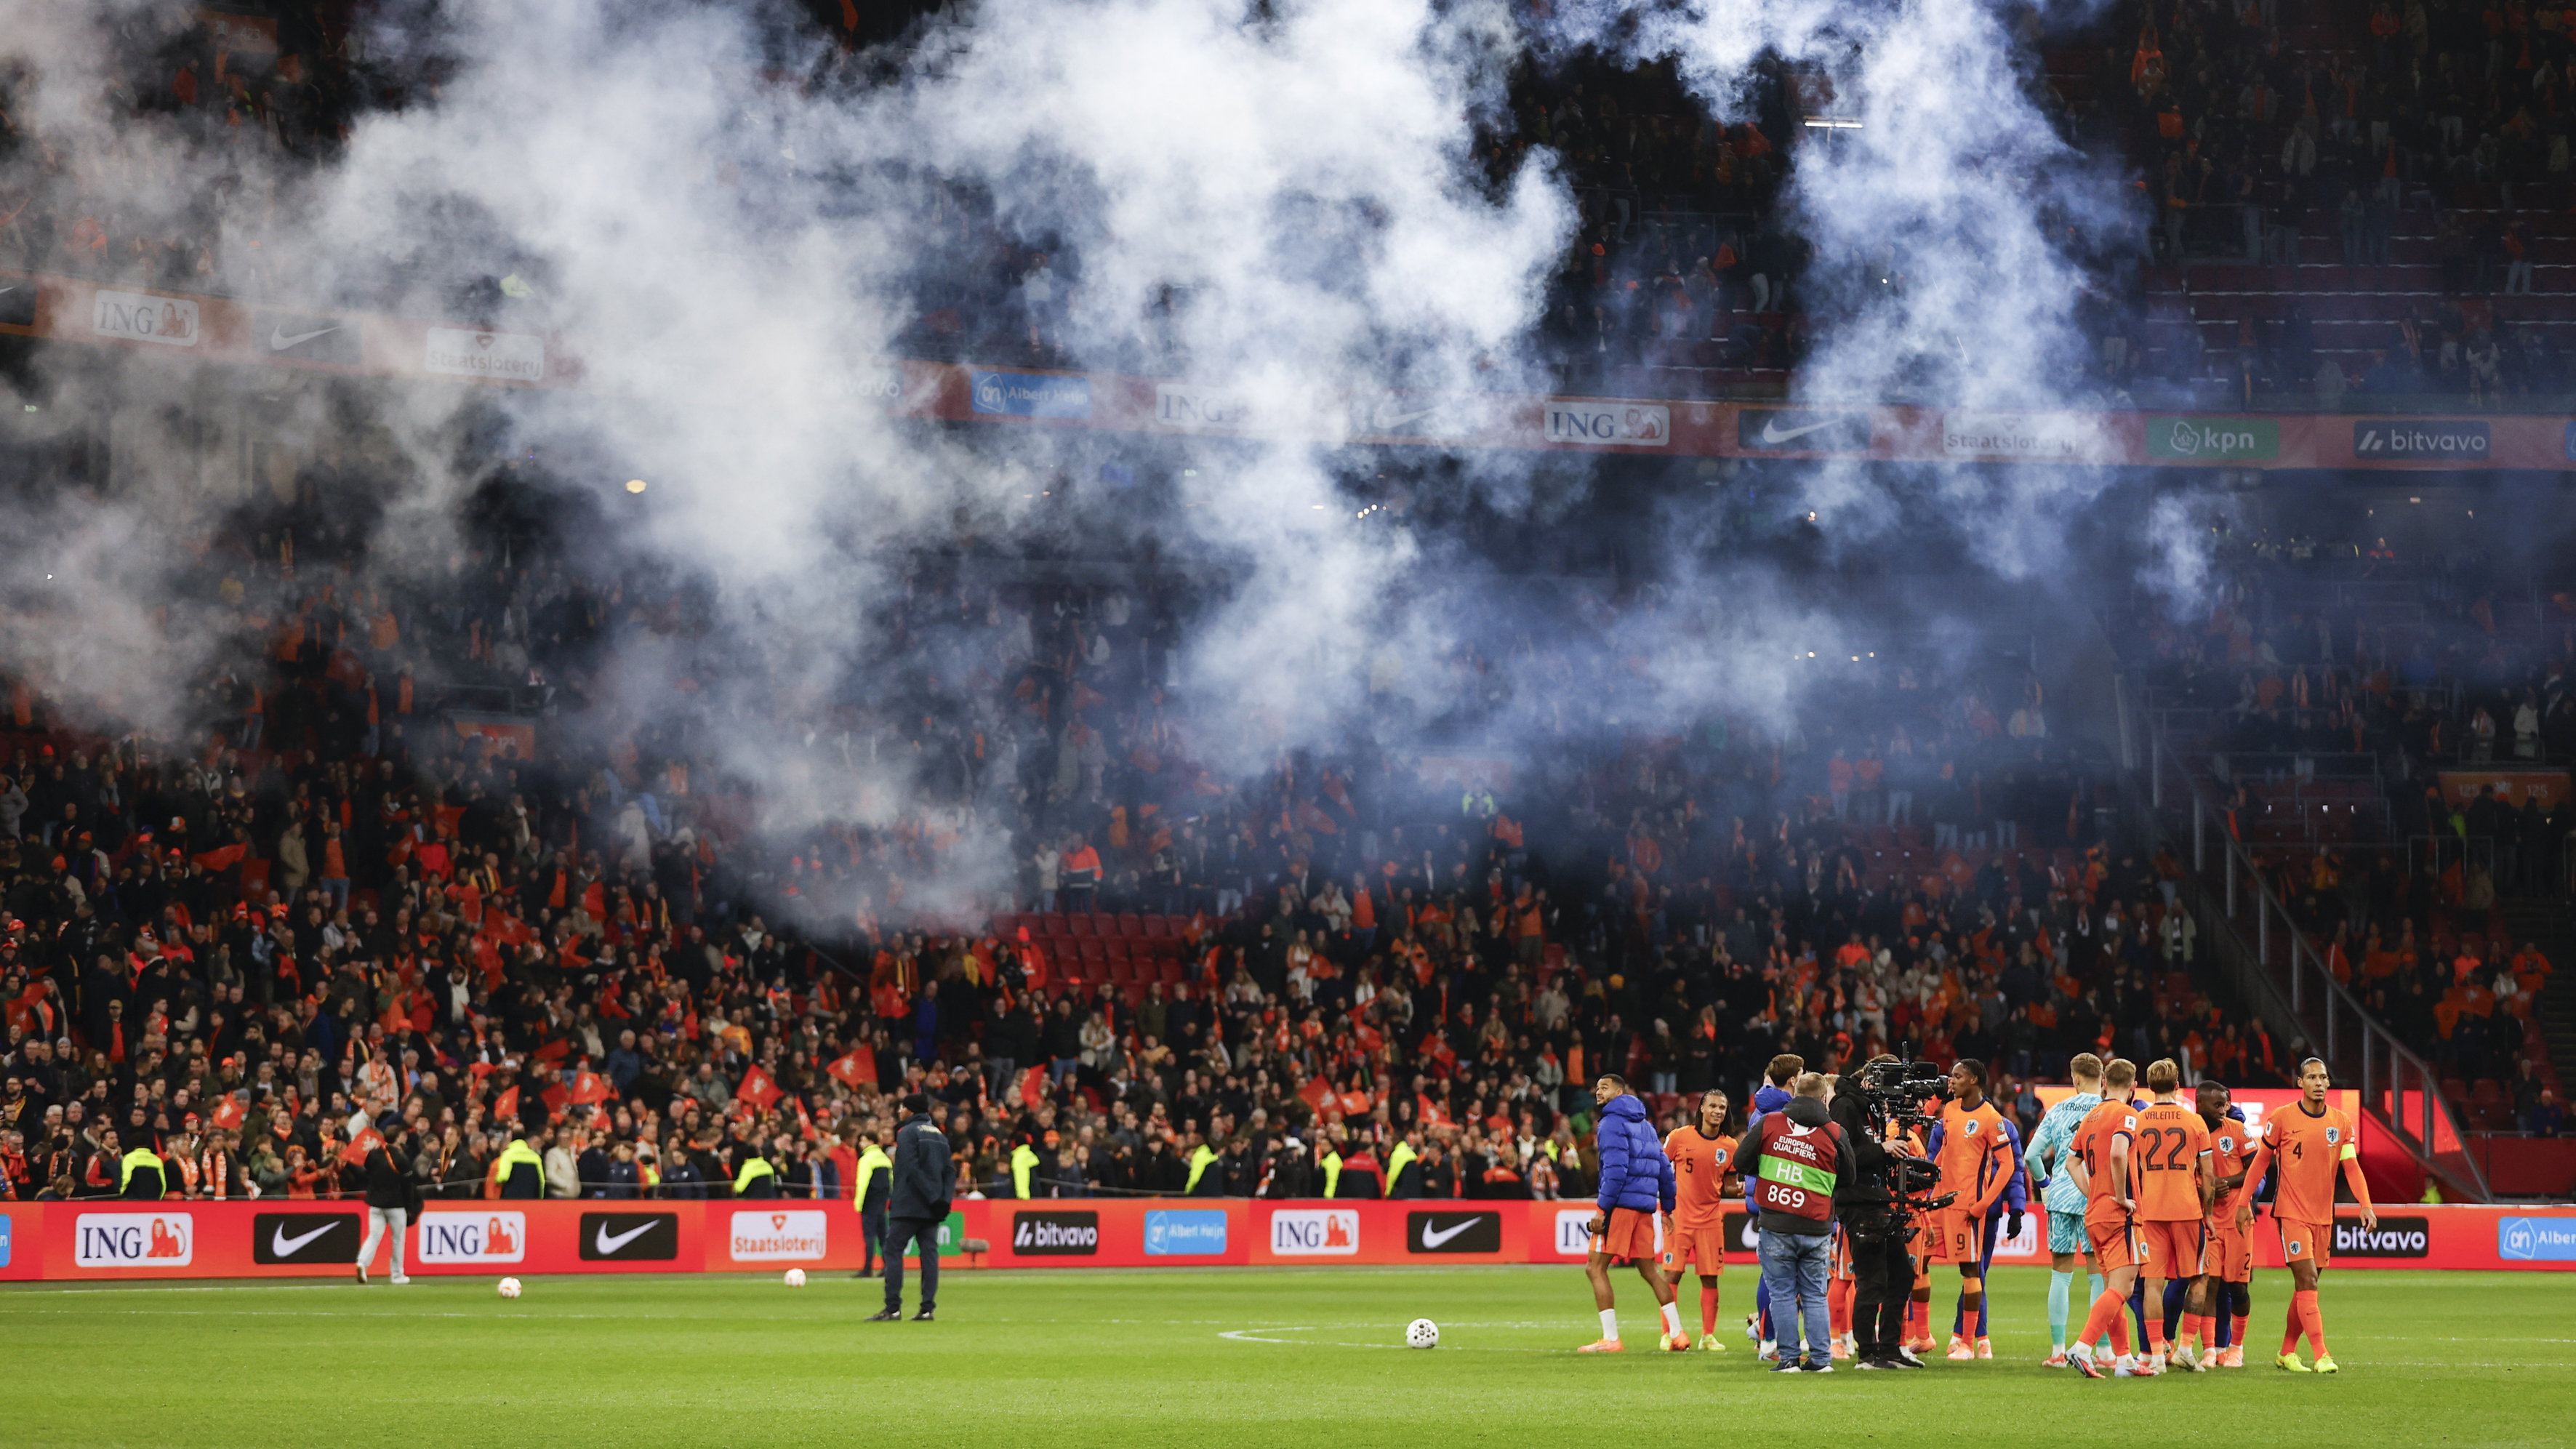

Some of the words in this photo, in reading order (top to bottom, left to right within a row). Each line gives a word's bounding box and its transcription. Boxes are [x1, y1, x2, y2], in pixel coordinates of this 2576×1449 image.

[100, 302, 154, 334] ING
[430, 350, 540, 377] Staatsloterij
[1008, 387, 1049, 401] Albert
[1162, 395, 1223, 422] ING
[1553, 412, 1614, 438] ING
[2204, 427, 2254, 454] kpn
[2391, 429, 2486, 451] bitvavo
[2145, 1111, 2181, 1120] VALENTE
[1773, 1141, 1817, 1160] QUALIFIERS
[1778, 1136, 1815, 1152] EUROPEAN
[2086, 1133, 2095, 1177] 6
[2140, 1128, 2187, 1171] 22
[2292, 1142, 2303, 1159] 4
[1685, 1157, 1693, 1173] 5
[1775, 1162, 1804, 1183] HB
[1768, 1184, 1805, 1208] 869
[426, 1224, 479, 1256] ING
[1035, 1220, 1098, 1247] bitvavo
[1169, 1224, 1198, 1237] Albert
[1277, 1221, 1320, 1248] ING
[2336, 1224, 2426, 1250] bitvavo
[2537, 1230, 2576, 1245] Alber
[82, 1227, 143, 1259] ING
[735, 1232, 824, 1255] Staatsloterij
[1957, 1234, 1965, 1251] 9
[1718, 1247, 1724, 1264] 5
[2244, 1253, 2251, 1270] 2
